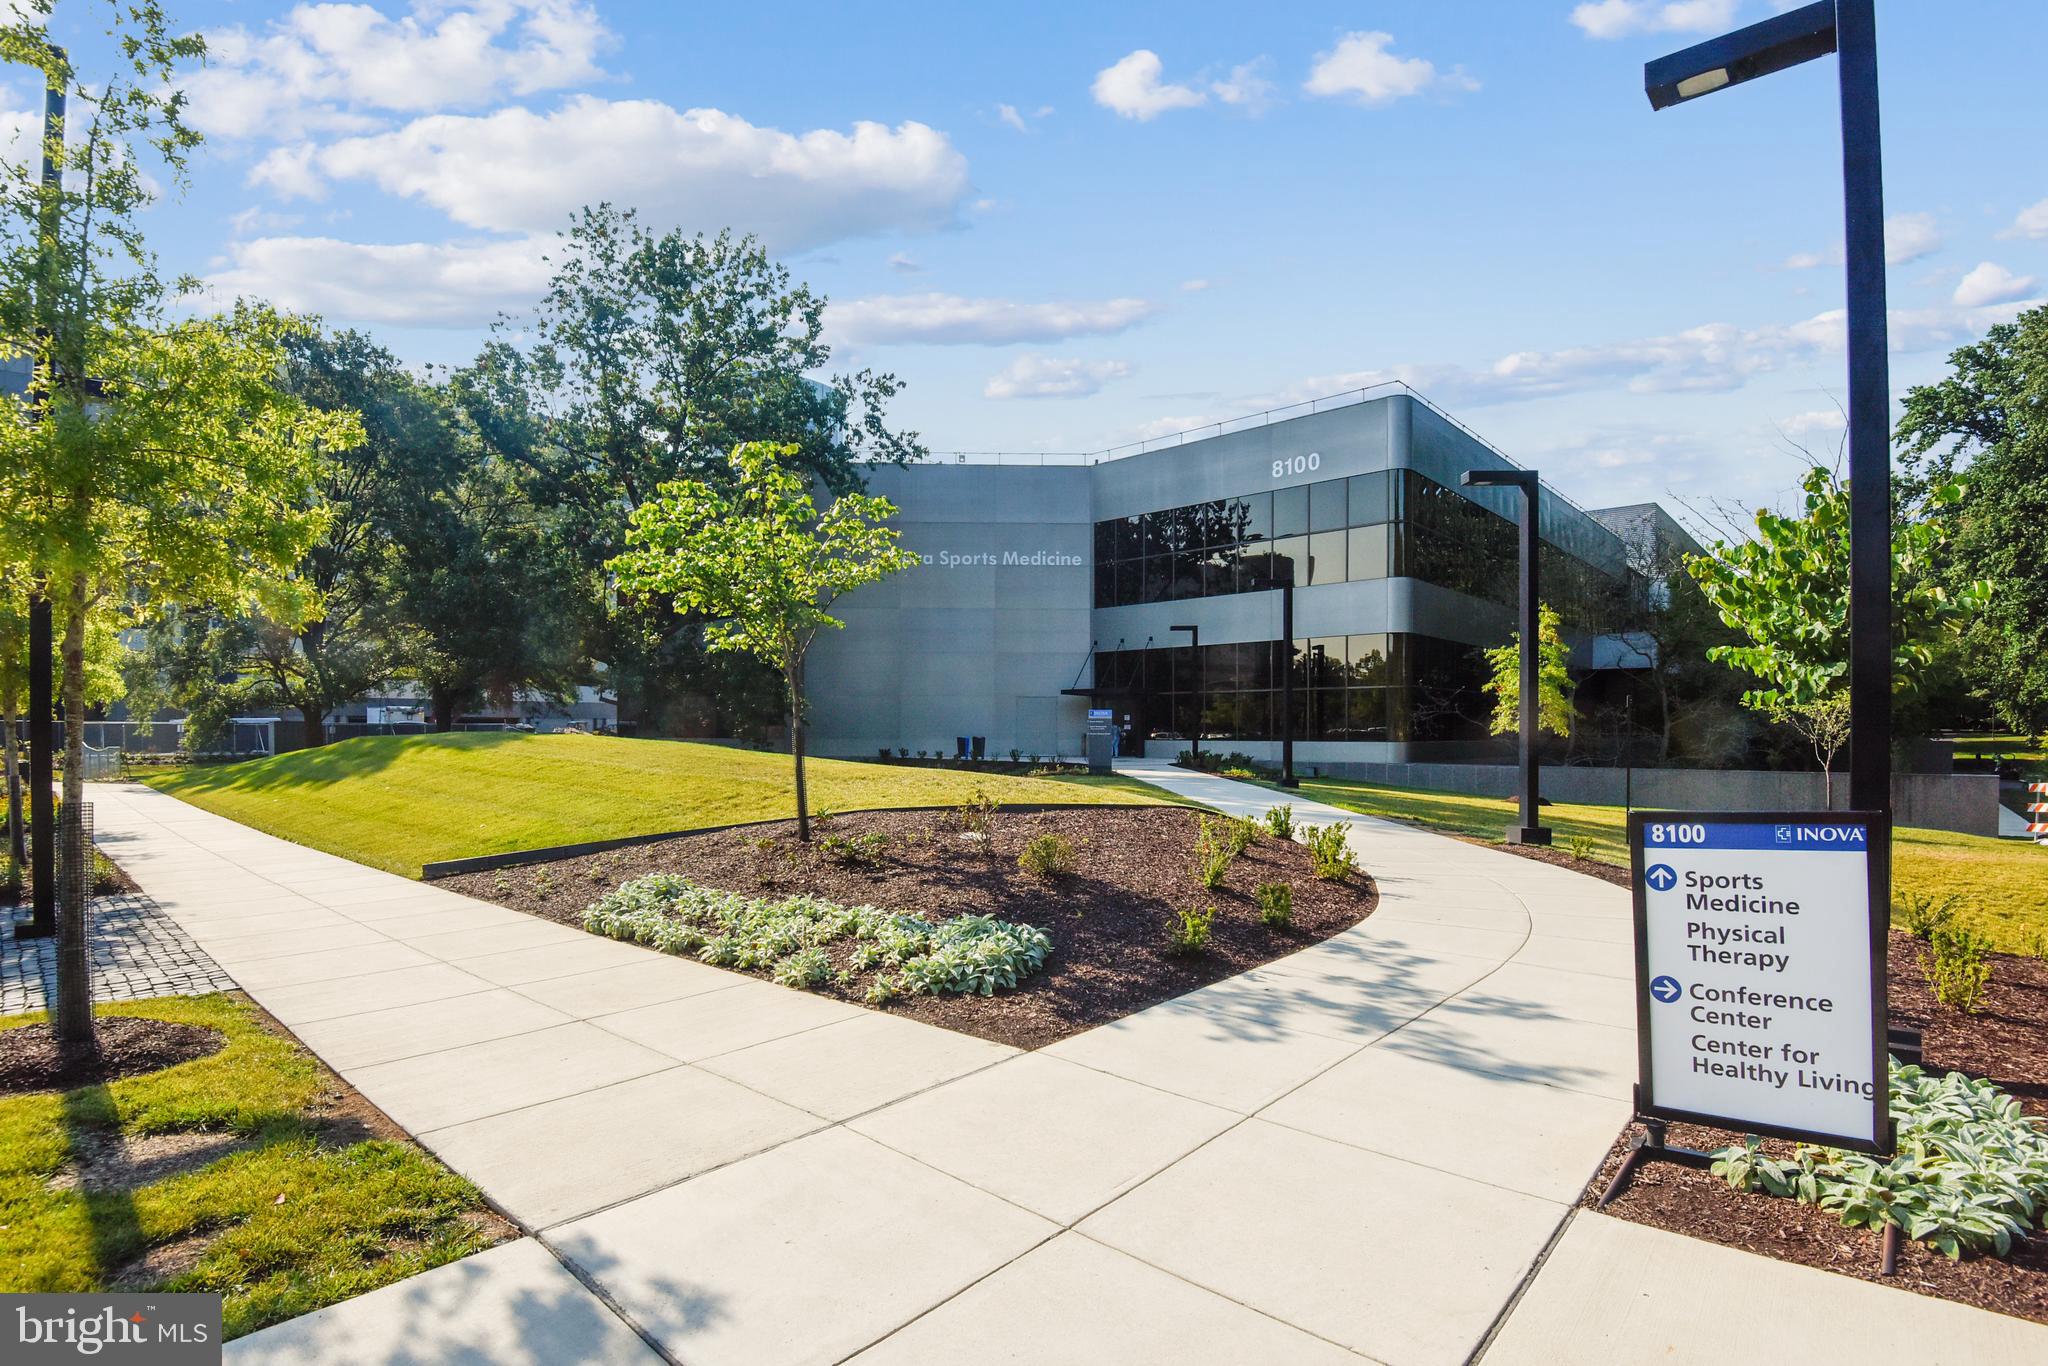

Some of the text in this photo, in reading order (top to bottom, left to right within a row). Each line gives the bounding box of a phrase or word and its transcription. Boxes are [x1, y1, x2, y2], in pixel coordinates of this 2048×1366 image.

[1272, 453, 1320, 478] 8100
[940, 550, 997, 568] Sports
[1003, 551, 1082, 566] Medicine
[1651, 824, 1706, 843] 8100
[1797, 827, 1864, 842] INOVA
[1685, 871, 1764, 892] Sports
[1686, 893, 1800, 915] Medicine
[1687, 922, 1785, 945] Physical
[1687, 945, 1790, 972] Therapy
[1689, 983, 1833, 1012] Conference
[1690, 1006, 1772, 1030] Center
[1691, 1034, 1820, 1065] Center for
[1693, 1056, 1875, 1101] Healthy Living
